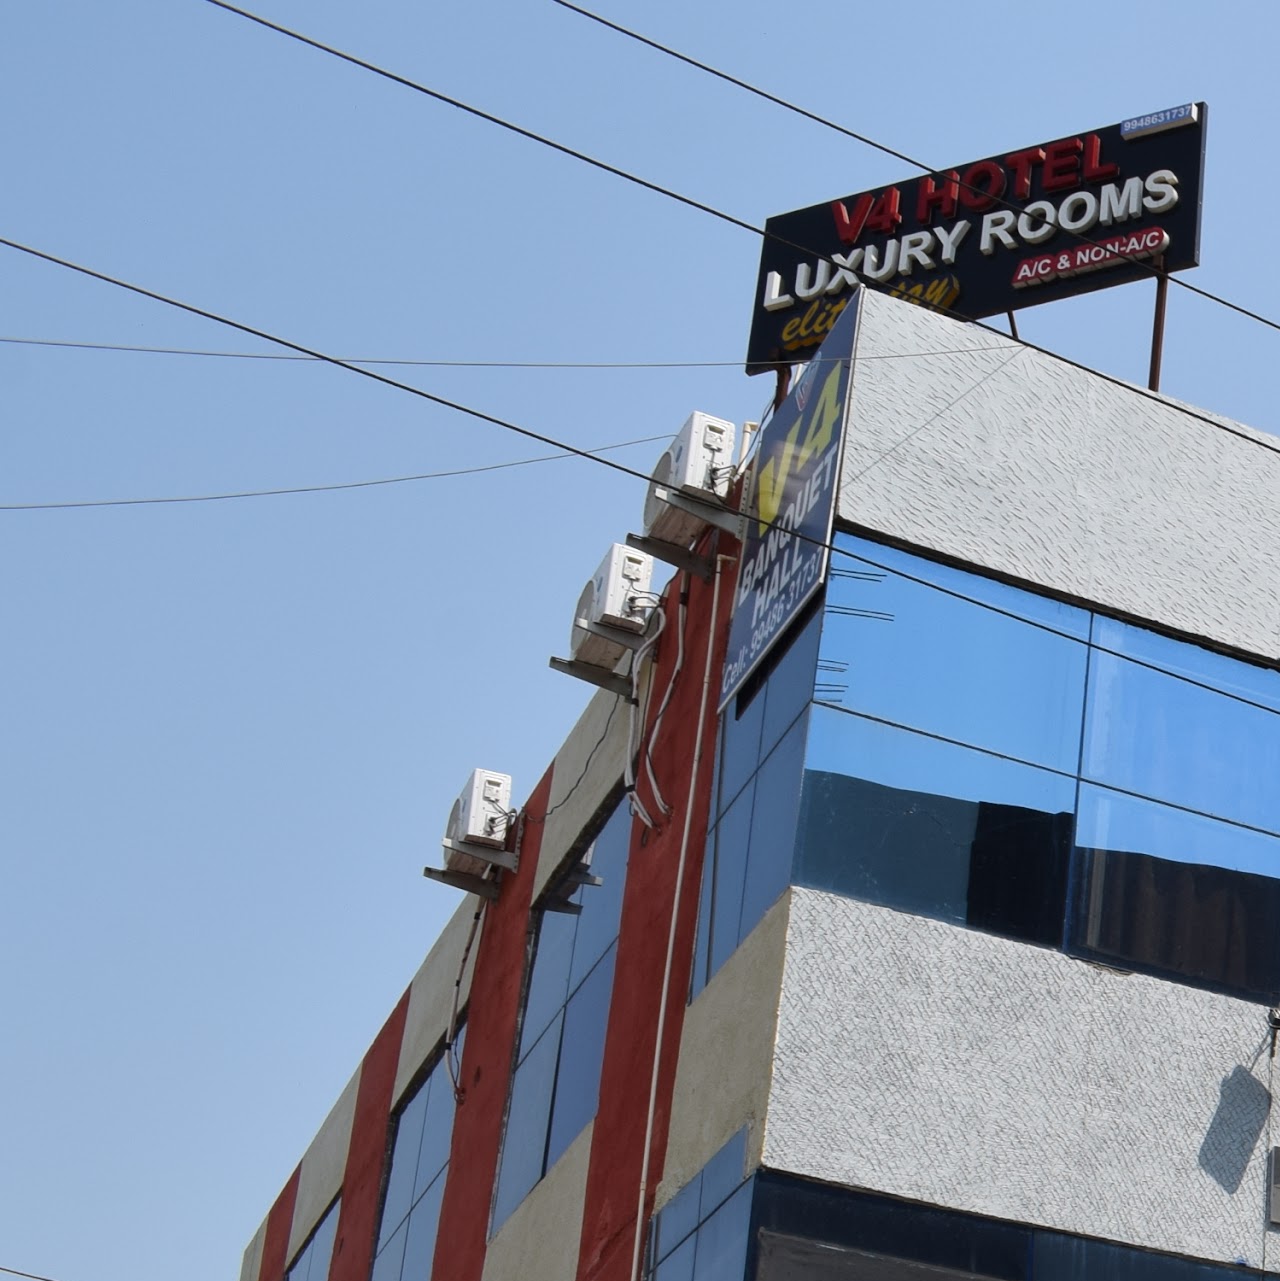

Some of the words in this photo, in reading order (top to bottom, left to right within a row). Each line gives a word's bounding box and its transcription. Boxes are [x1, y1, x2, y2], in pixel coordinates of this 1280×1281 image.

[1124, 105, 1191, 131] 9948631737
[763, 219, 971, 311] LUXURY
[980, 169, 1181, 256] ROOMS
[833, 186, 902, 245] V4
[916, 134, 1120, 224] HOTEL
[1017, 259, 1051, 280] A/C
[1057, 254, 1070, 270] &
[1076, 231, 1160, 266] NON-A/C
[782, 298, 847, 342] elit
[759, 360, 842, 539] V4
[739, 442, 838, 606] BANQUET
[751, 533, 803, 629] HALL
